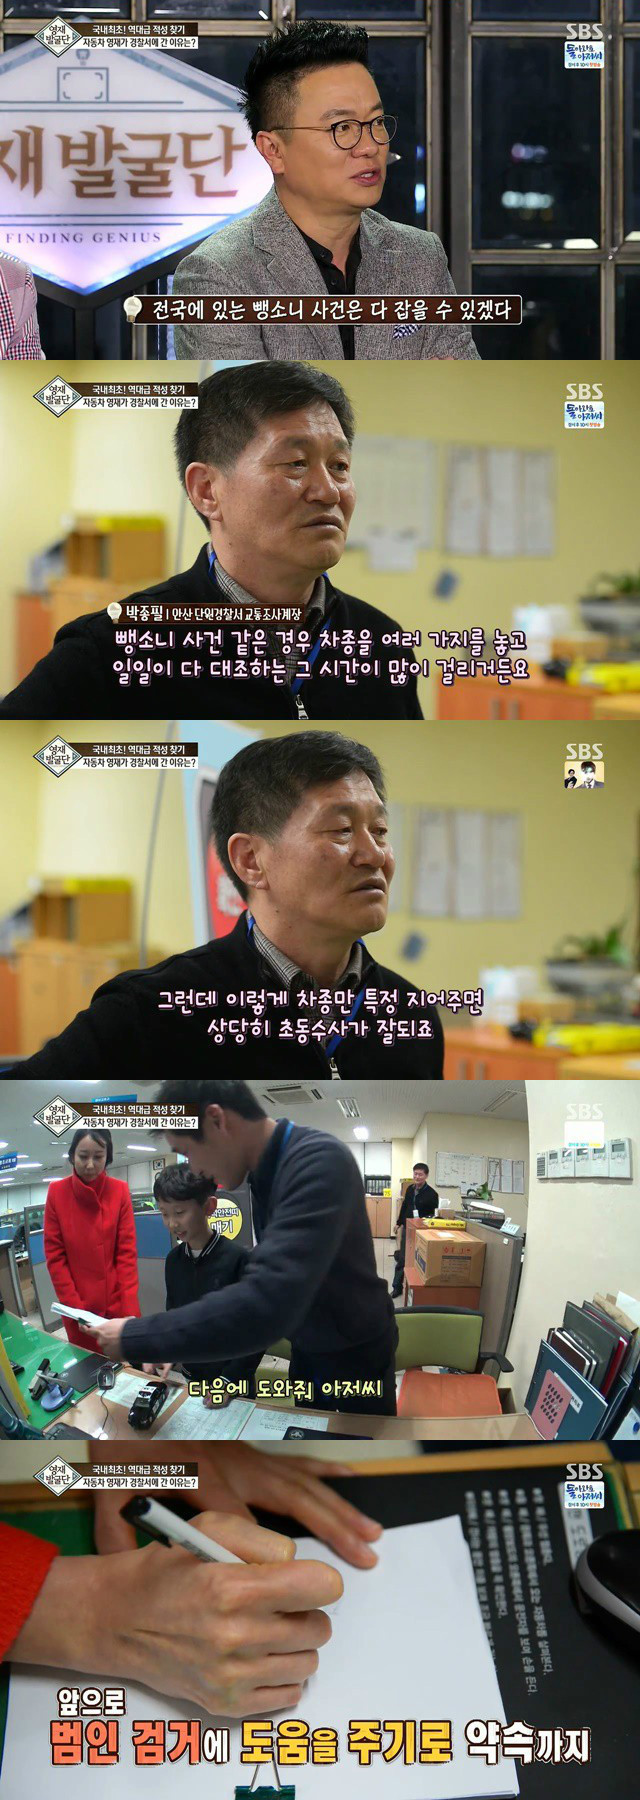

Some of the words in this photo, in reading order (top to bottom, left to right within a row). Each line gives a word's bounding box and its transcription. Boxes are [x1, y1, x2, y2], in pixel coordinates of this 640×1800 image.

[55, 124, 247, 199] 발굴단
[6, 232, 83, 244] FINDING
[92, 232, 161, 243] GENIUS
[212, 1208, 239, 1218] 안전띠
